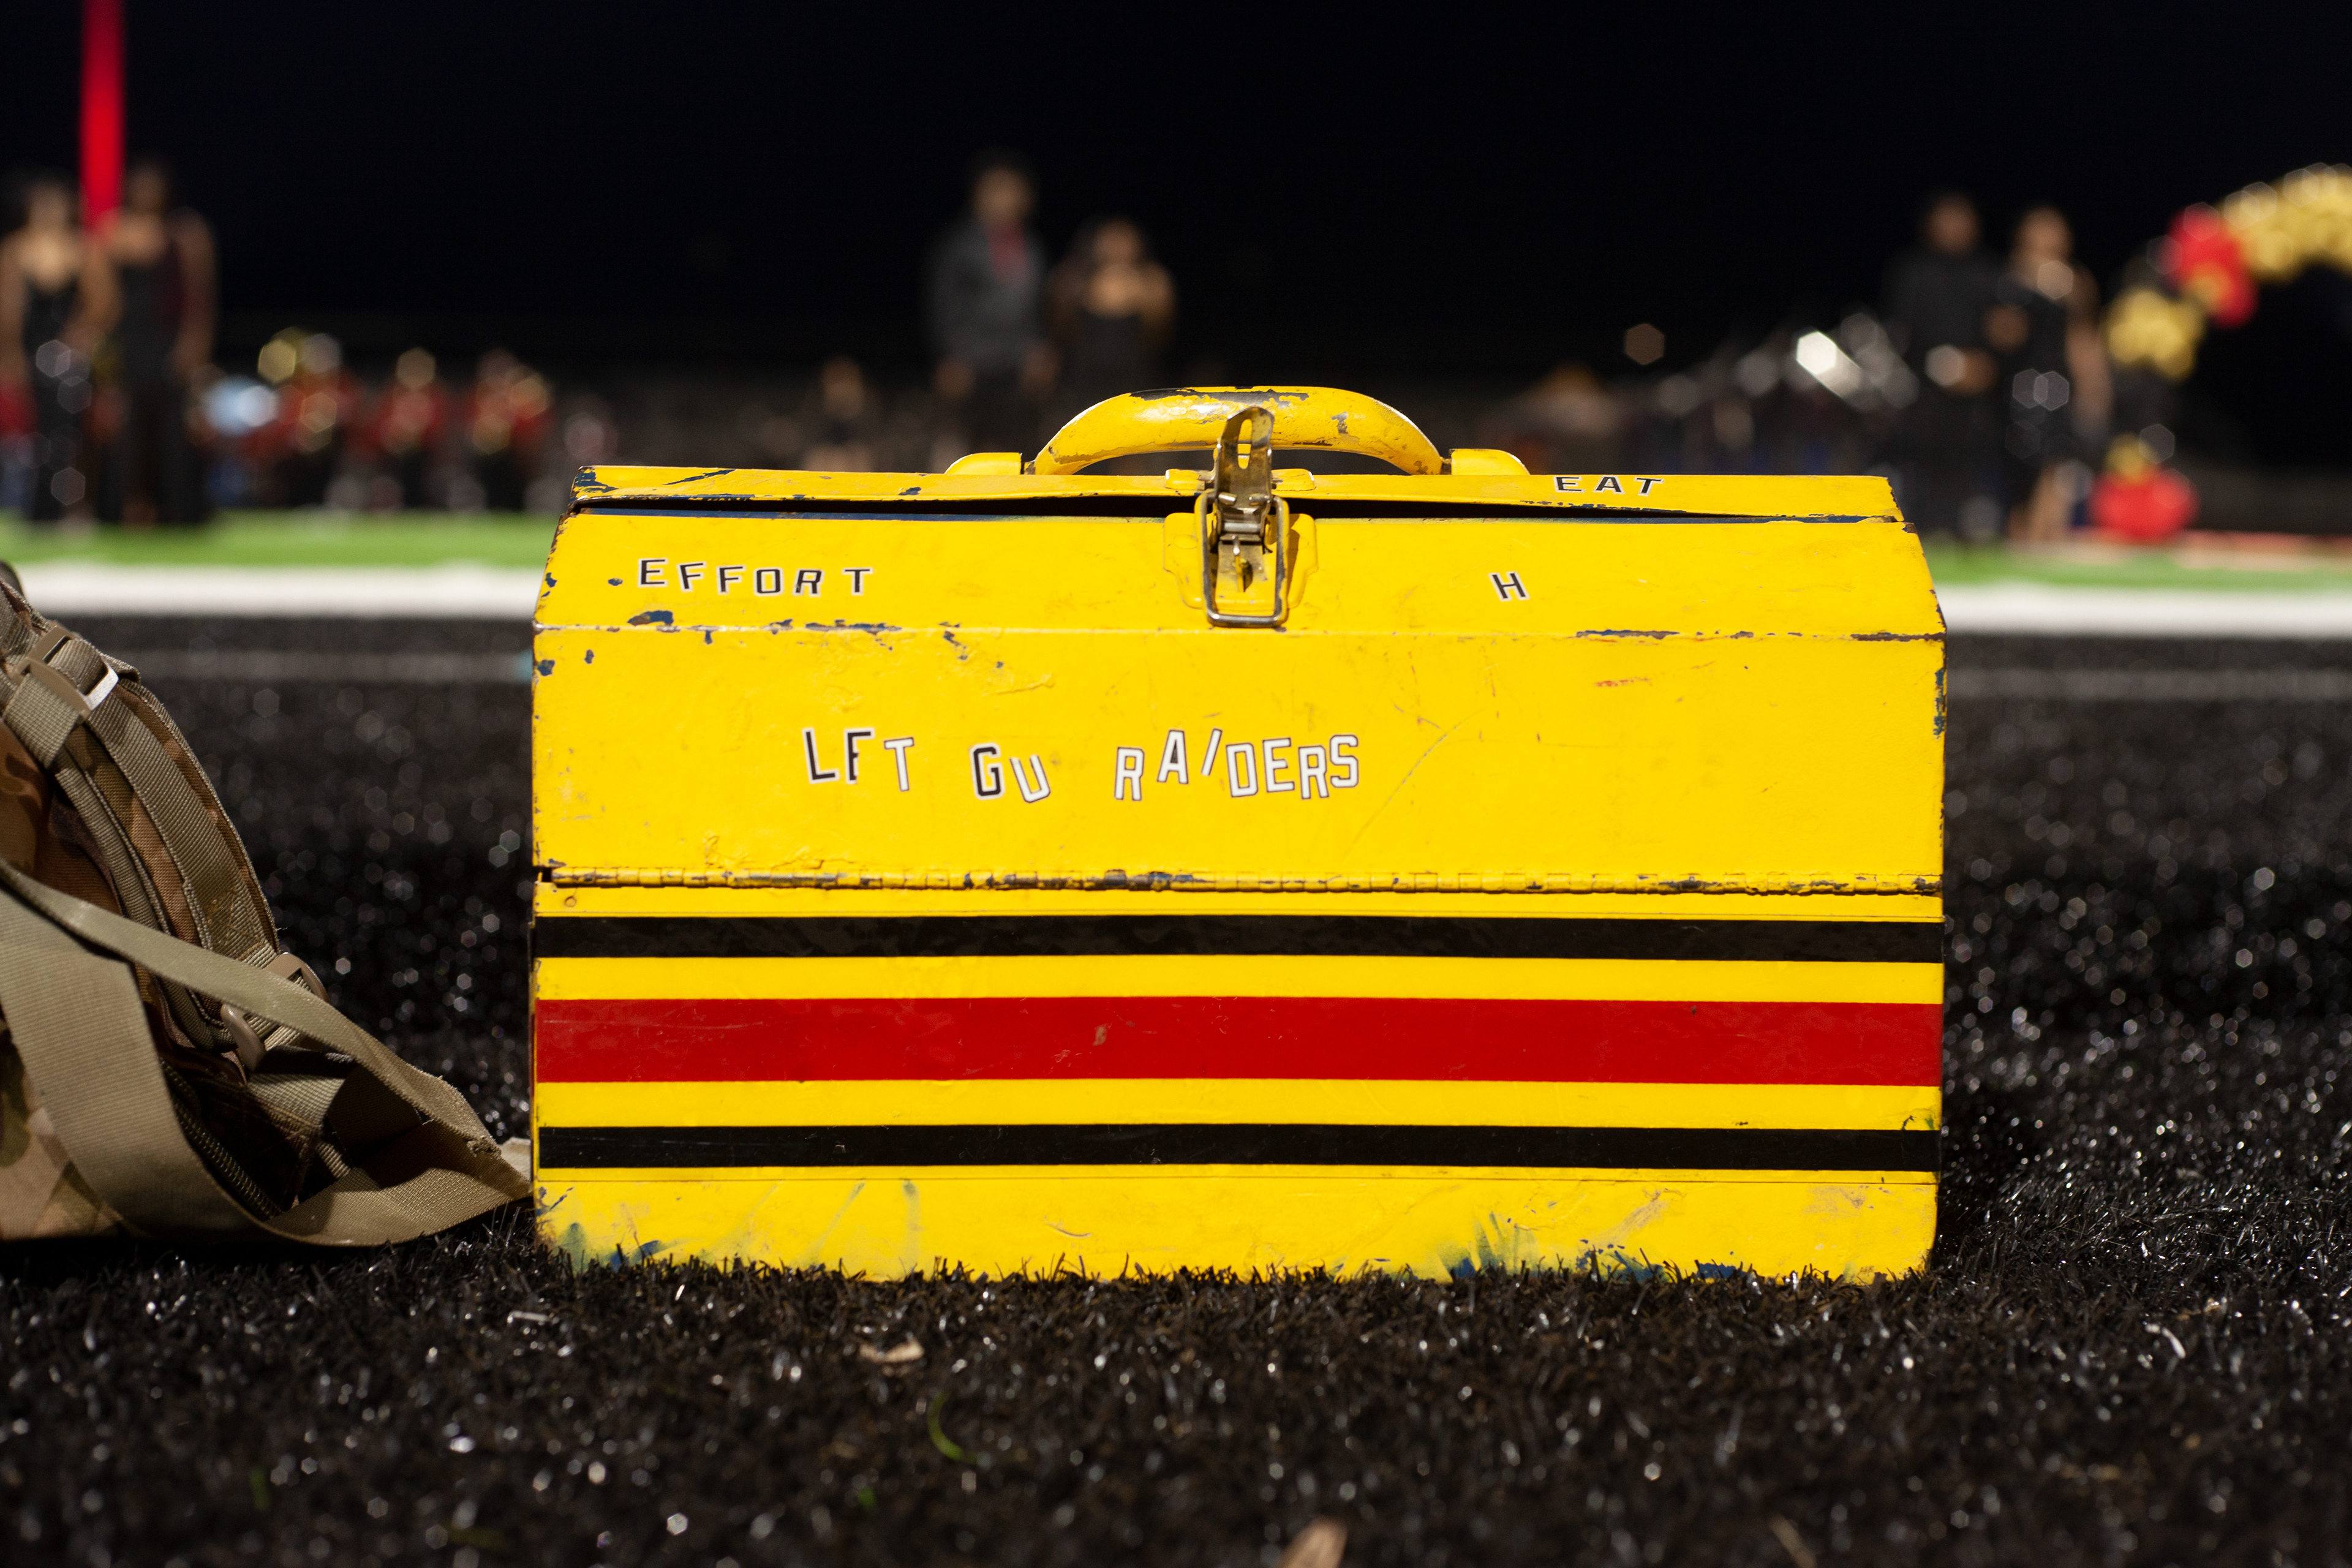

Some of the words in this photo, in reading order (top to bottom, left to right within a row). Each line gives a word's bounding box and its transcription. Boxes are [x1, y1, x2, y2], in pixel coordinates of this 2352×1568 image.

[1554, 475, 1664, 496] EAT
[638, 557, 873, 596] EFFORT
[1114, 728, 1359, 801] RAIDERS
